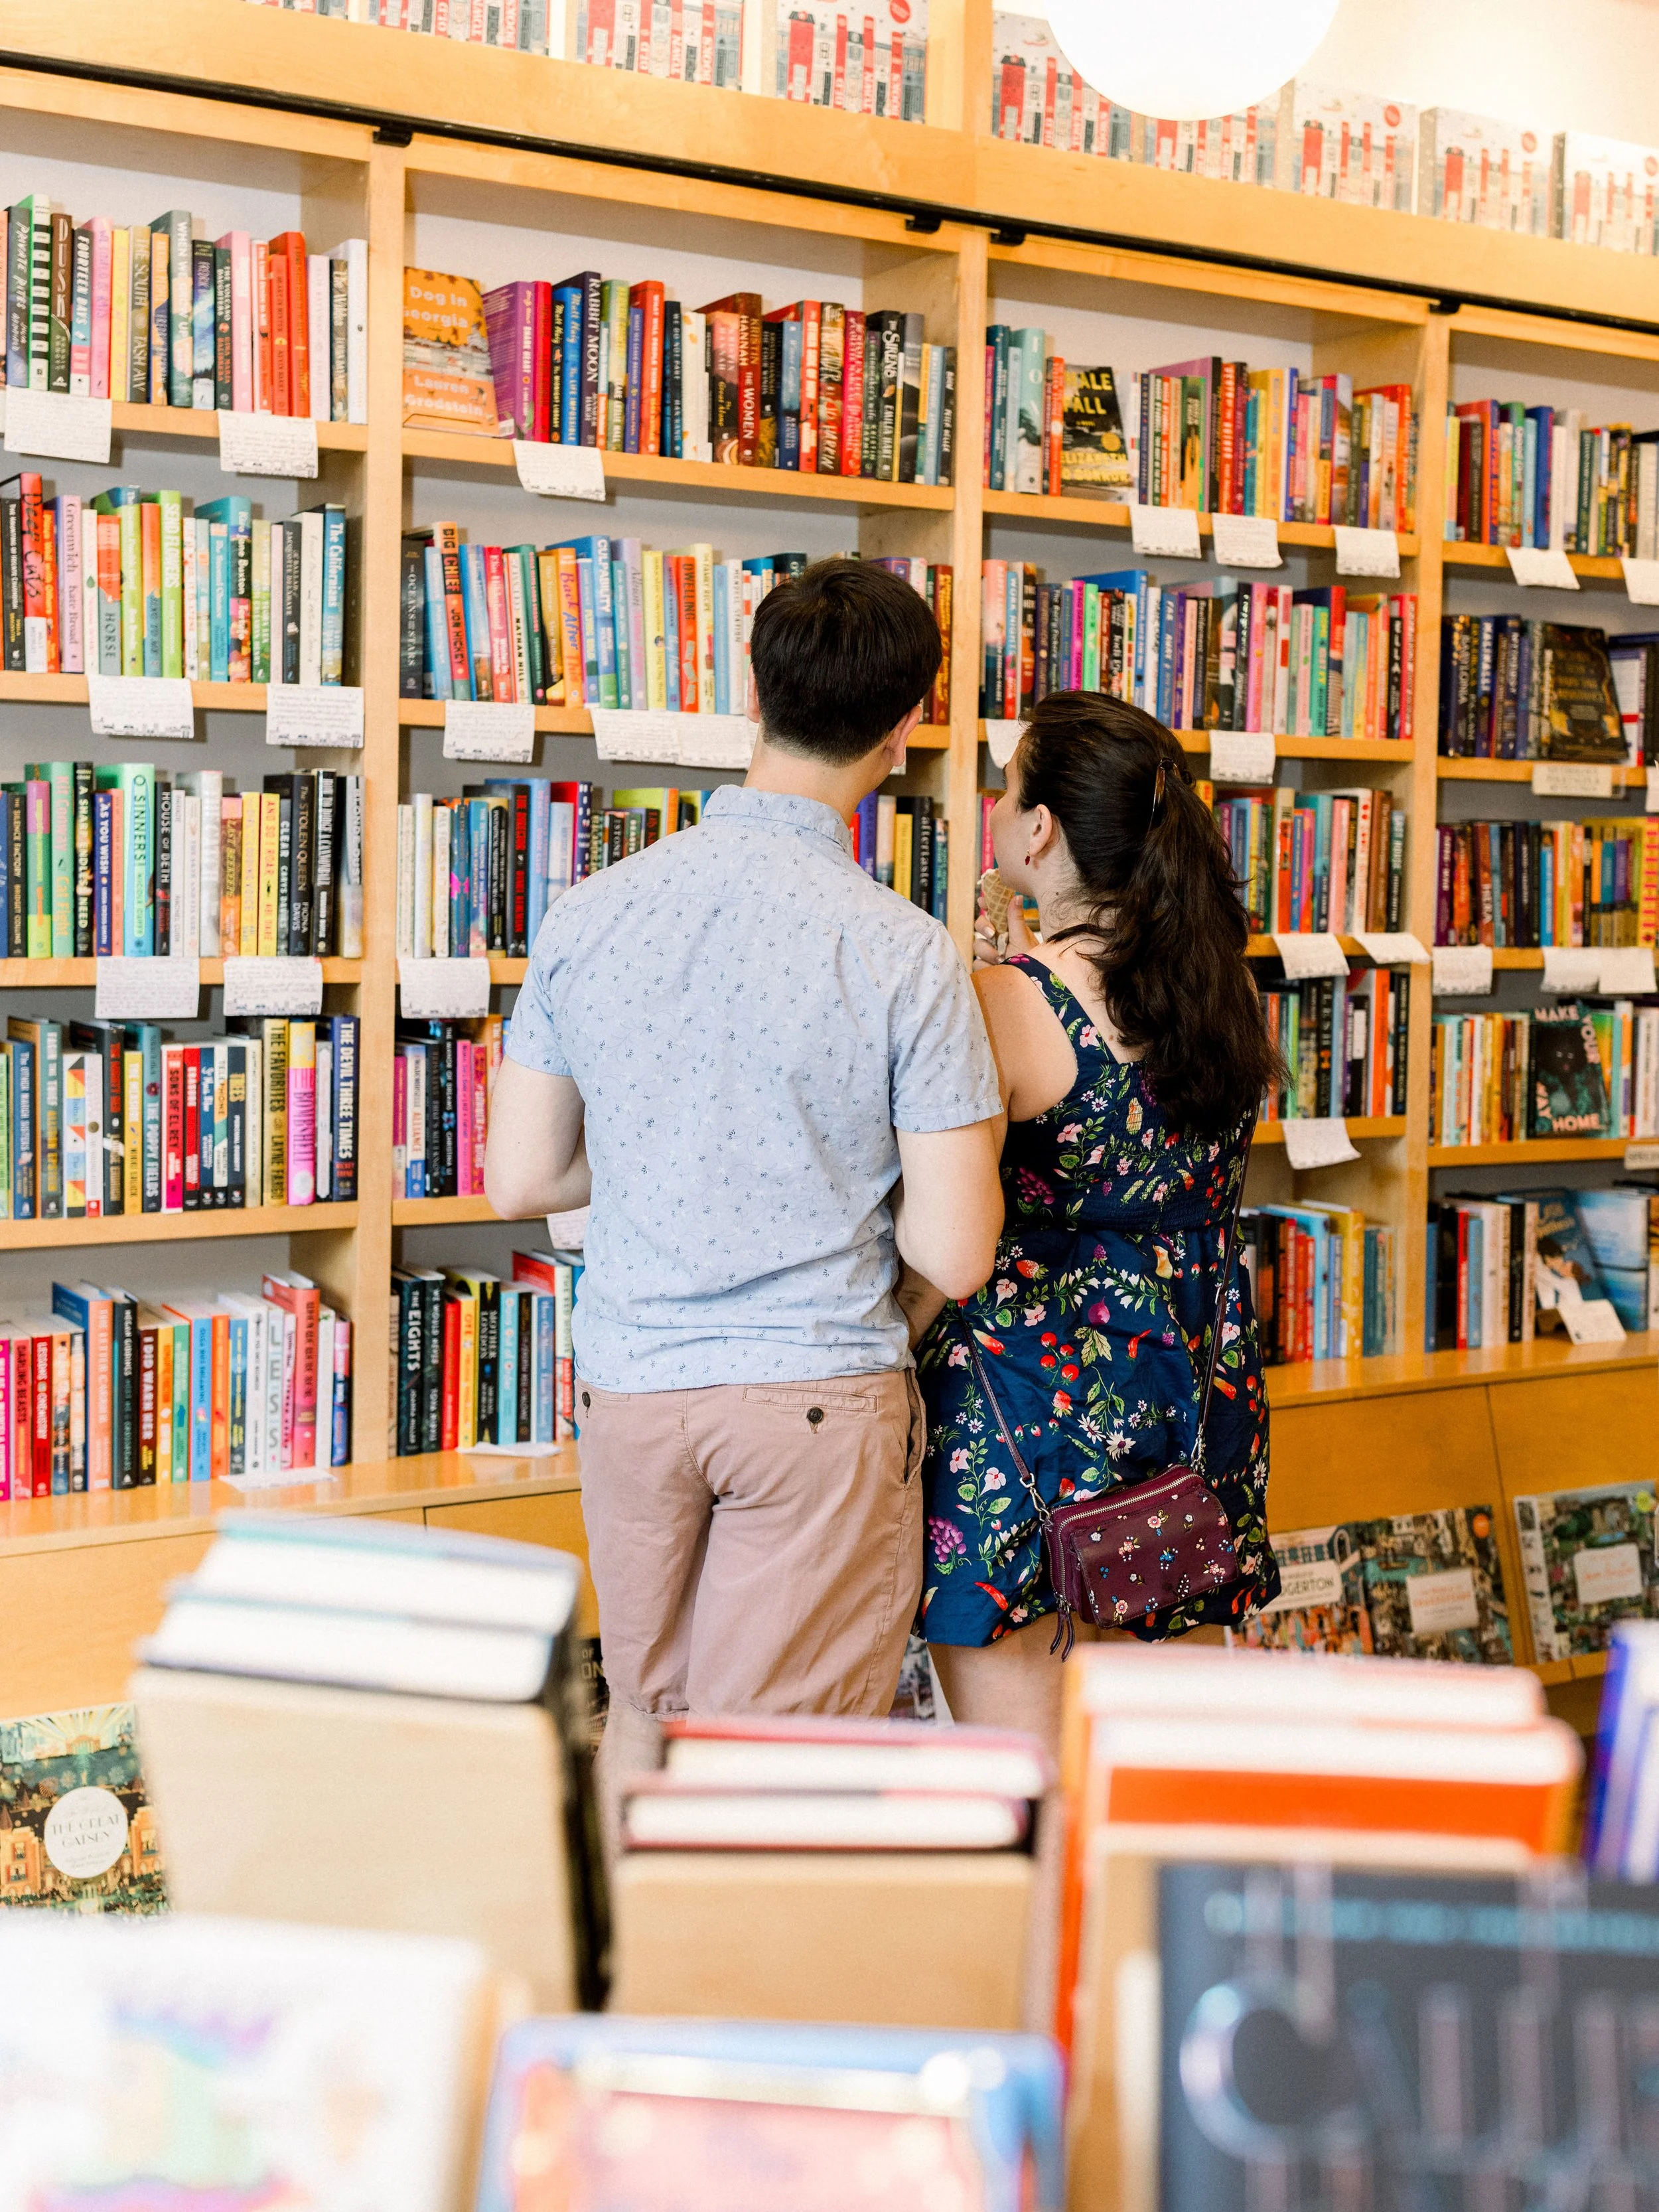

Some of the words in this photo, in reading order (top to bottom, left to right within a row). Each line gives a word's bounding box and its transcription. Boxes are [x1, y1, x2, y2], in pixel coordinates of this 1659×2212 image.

[640, 42, 649, 70] OLD
[671, 35, 682, 75] TOWN
[701, 37, 713, 82] BOOKS
[835, 78, 844, 105] OLD
[862, 72, 873, 109] TOWN
[14, 222, 30, 271] PRIVATE
[135, 238, 148, 259] THE
[177, 222, 188, 256] WHEN
[57, 218, 68, 319] DUSK
[76, 236, 90, 295] FOURTEEN
[177, 261, 188, 277] WE
[333, 271, 346, 290] The
[13, 277, 28, 309] RITES
[134, 264, 149, 307] SOUTH
[410, 287, 446, 305] Dog
[76, 297, 89, 325] DAYS
[570, 293, 582, 319] Matt
[588, 278, 601, 332] RABBIT
[178, 321, 190, 338] UP
[523, 327, 532, 350] SHARK
[566, 321, 581, 343] Haig
[739, 315, 749, 366] HANNAH
[749, 319, 760, 364] KRISTIN
[133, 334, 147, 366] TASH
[522, 351, 531, 373] HEART
[586, 335, 599, 382] MOON
[650, 337, 659, 366] PEOPLE
[882, 331, 900, 378] SIRENS
[133, 368, 147, 392] AW
[414, 376, 469, 394] Lauren
[745, 372, 754, 386] THE
[405, 395, 483, 416] Grodstein
[568, 398, 577, 441] IMPOSSIBLE
[743, 388, 755, 439] WOMEN
[883, 405, 895, 437] EMILIA
[822, 425, 837, 470] HARKIN
[21, 493, 42, 542] Deep
[164, 504, 178, 535] SEND
[329, 523, 344, 543] The
[44, 542, 53, 561] Well
[65, 503, 78, 573] Greenwich
[443, 528, 454, 548] BIG
[23, 551, 44, 598] Cuts
[45, 563, 54, 583] with
[164, 536, 179, 587] FLOWERS
[238, 559, 248, 595] Buxton
[327, 545, 342, 607] Californians
[444, 556, 459, 591] CHIEF
[597, 539, 611, 613] CULPABILITY
[44, 585, 54, 615] Others
[407, 573, 416, 621] OCEANS
[560, 573, 579, 609] Back
[682, 563, 695, 620] DWELLING
[1008, 577, 1017, 611] WORK
[451, 609, 461, 627] JON
[562, 611, 580, 650] After
[104, 613, 116, 660] HORSE
[407, 631, 416, 666] STARS
[453, 631, 465, 666] HICKEY
[56, 775, 69, 796] Kit
[80, 786, 88, 795] A
[100, 803, 109, 818] AS
[161, 791, 171, 834] HOUSE
[267, 801, 276, 822] AND
[516, 794, 527, 810] THE
[54, 798, 69, 851] Conway
[79, 799, 88, 838] SHARP
[100, 820, 109, 843] YOU
[267, 825, 276, 838] SO
[298, 803, 309, 848] STOLEN
[280, 820, 289, 857] CLEAR
[920, 816, 932, 887] aftertaste
[100, 845, 109, 874] WISH
[161, 853, 171, 883] BETH
[265, 849, 275, 875] ROAR
[297, 850, 308, 891] QUEEN
[56, 876, 69, 898] Cat
[52, 902, 69, 936] Fight
[79, 897, 88, 928] NEED
[292, 903, 301, 931] DAVIS
[1534, 1003, 1578, 1023] MAKE
[46, 1031, 57, 1060] FAGIN
[271, 1027, 285, 1045] THE
[340, 1021, 354, 1045] THE
[1580, 1013, 1601, 1065] YOUR
[340, 1047, 353, 1078] DEVIL
[170, 1069, 179, 1096] SONS
[270, 1051, 285, 1112] FAVORITES
[147, 1102, 159, 1121] THE
[169, 1099, 179, 1112] OF
[338, 1080, 353, 1119] THREE
[169, 1115, 179, 1126] EL
[293, 1092, 315, 1165] BOMBSHELL
[1551, 1113, 1602, 1132] HOME
[146, 1124, 159, 1159] POPPY
[169, 1130, 179, 1147] REY
[271, 1136, 285, 1167] LAYNE
[338, 1122, 352, 1159] TIMES
[146, 1161, 159, 1197] FIELDS
[271, 1169, 285, 1200] FARGO
[431, 1288, 441, 1302] WE
[431, 1303, 440, 1335] WOULD
[479, 1311, 488, 1359] LONDON
[488, 1310, 497, 1359] MOTHER
[407, 1309, 422, 1371] EIGHTS
[431, 1338, 439, 1364] NEVER
[37, 1341, 47, 1380] LESSONS
[143, 1345, 154, 1368] DID
[143, 1370, 154, 1411] WARN
[268, 1325, 283, 1449] LESS
[37, 1392, 48, 1439] CHEMISTRY
[142, 1413, 153, 1440] HER
